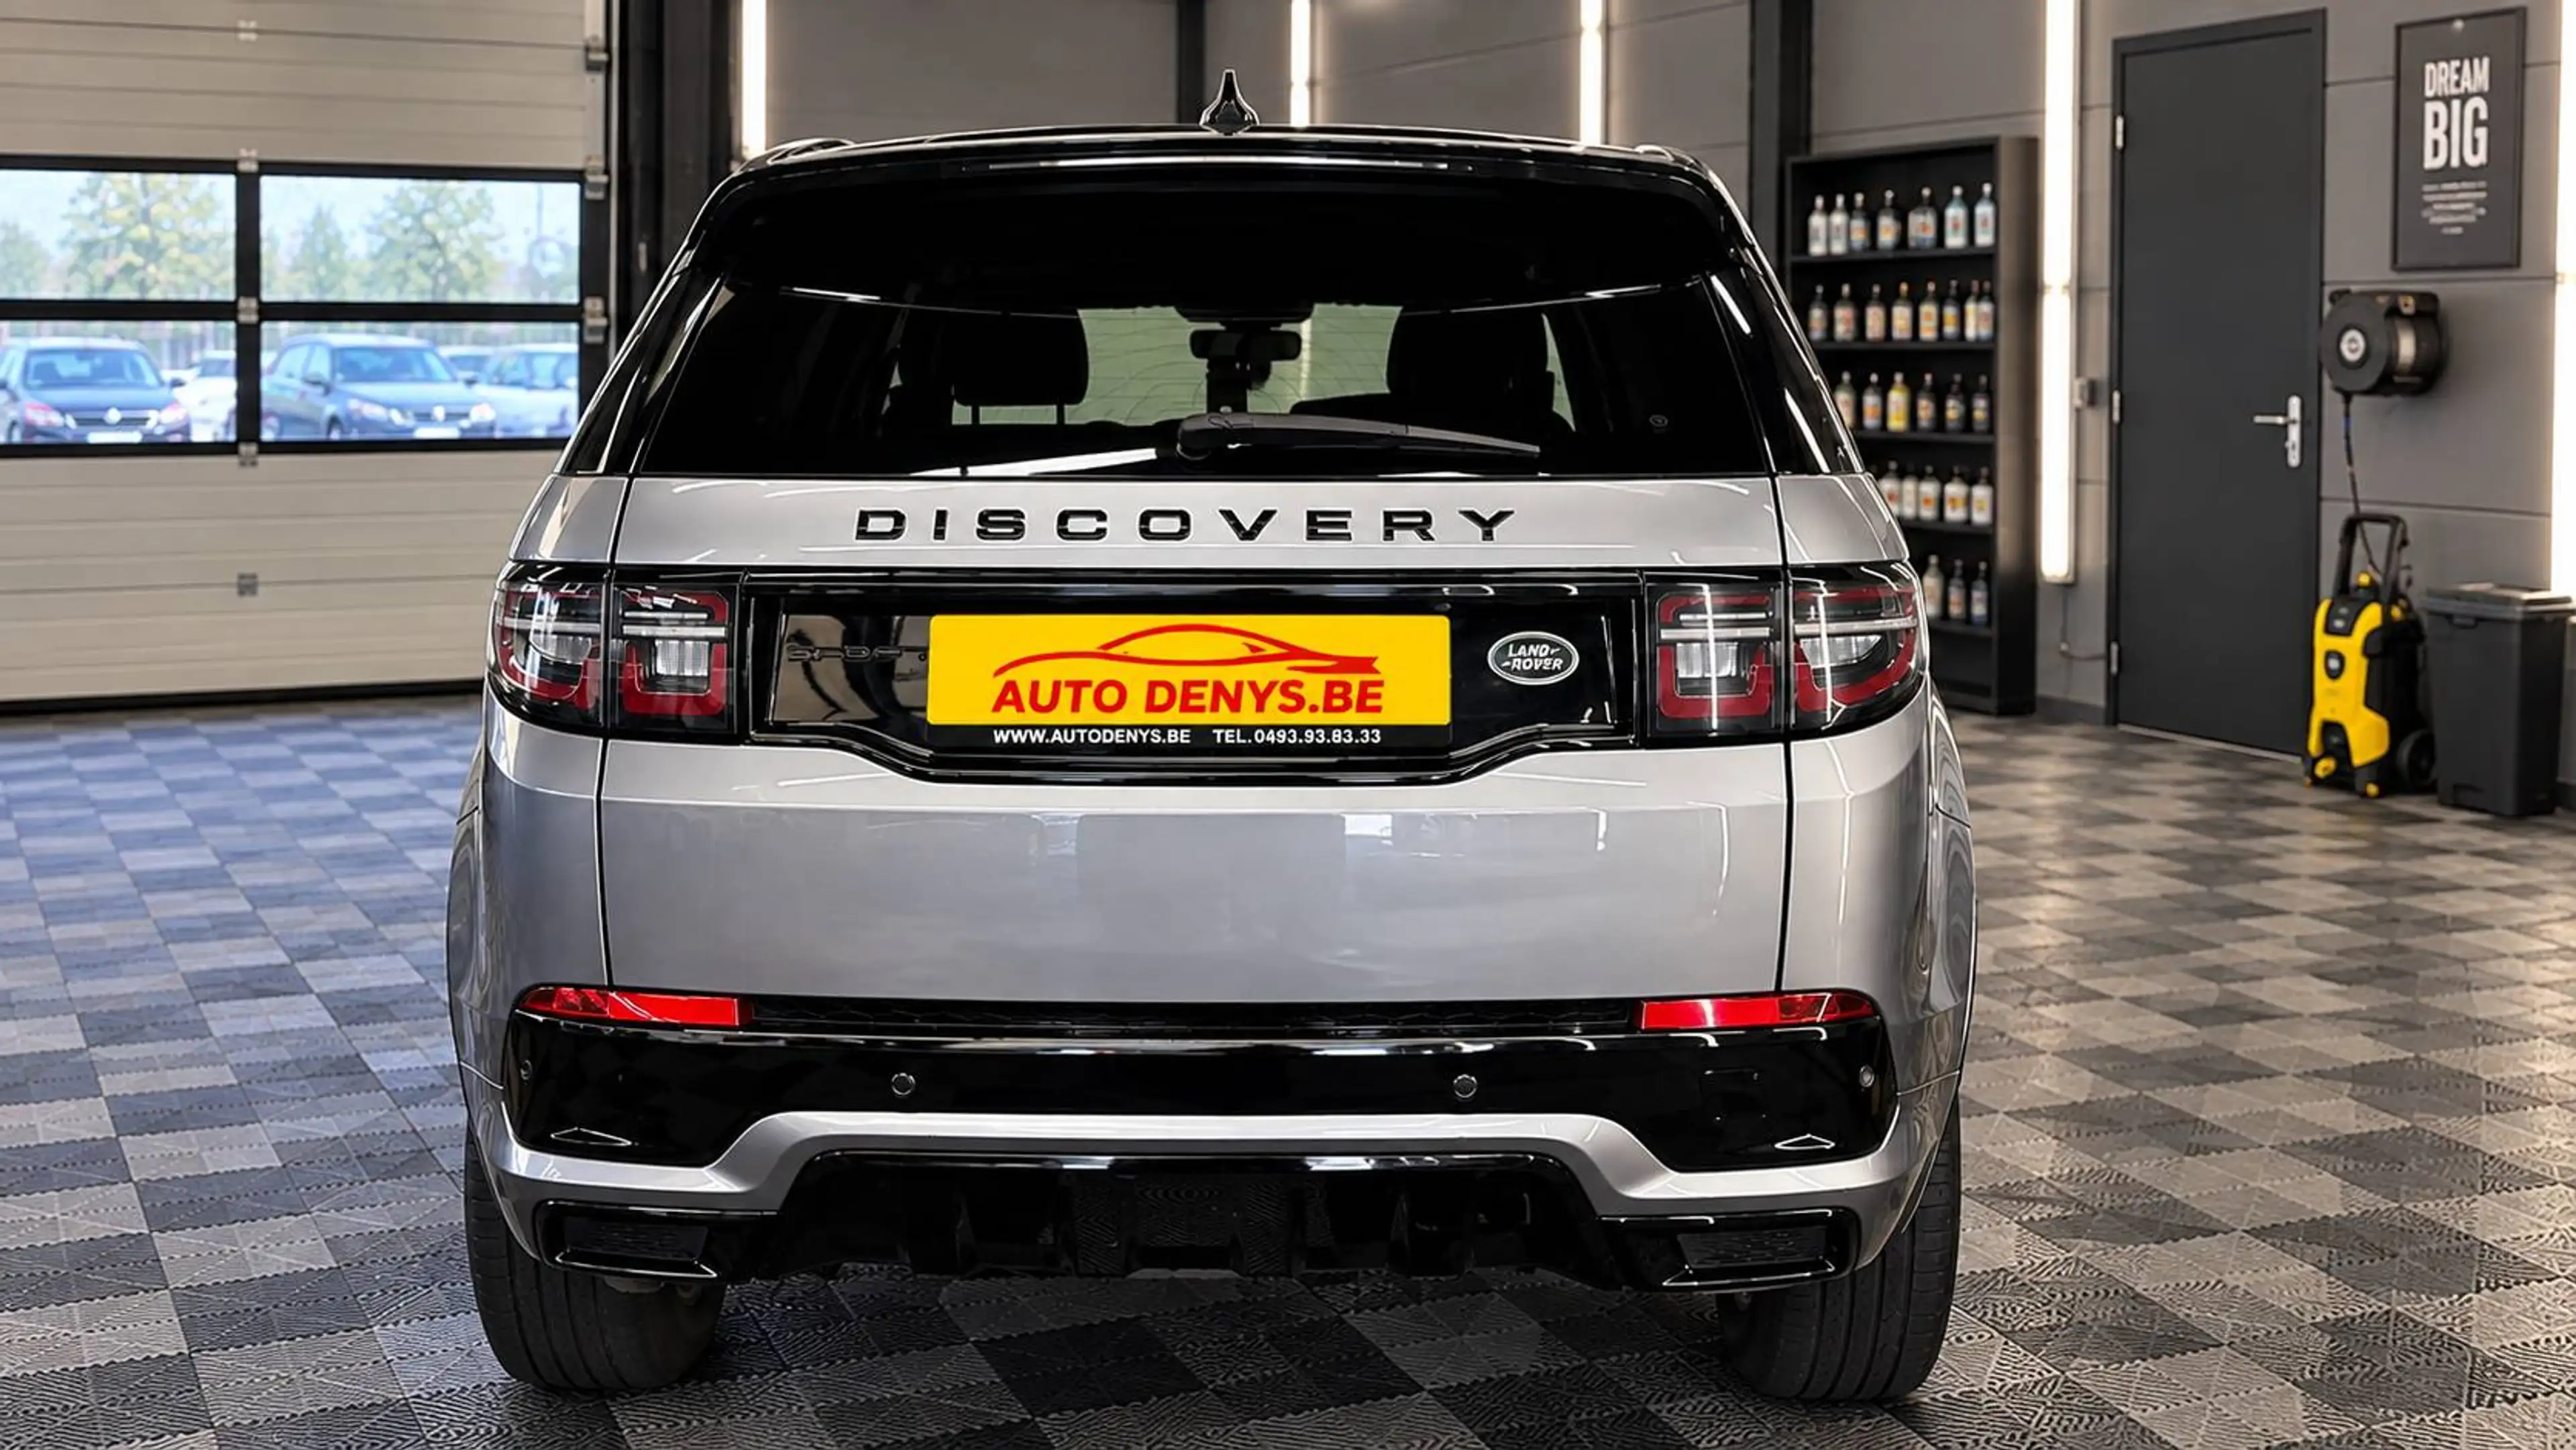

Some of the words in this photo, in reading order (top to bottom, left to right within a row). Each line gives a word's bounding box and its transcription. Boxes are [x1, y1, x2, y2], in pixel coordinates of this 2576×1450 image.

[2424, 56, 2490, 98] DREAM
[2423, 97, 2489, 170] BIG
[855, 509, 1515, 541] DISCOVERY
[1507, 643, 1550, 658] LAND
[1511, 658, 1564, 670] ROVER
[991, 679, 1128, 714] AUTO
[1144, 679, 1385, 714] DENYS.BE
[993, 729, 1191, 744] WWW.AUTODENYS.BE
